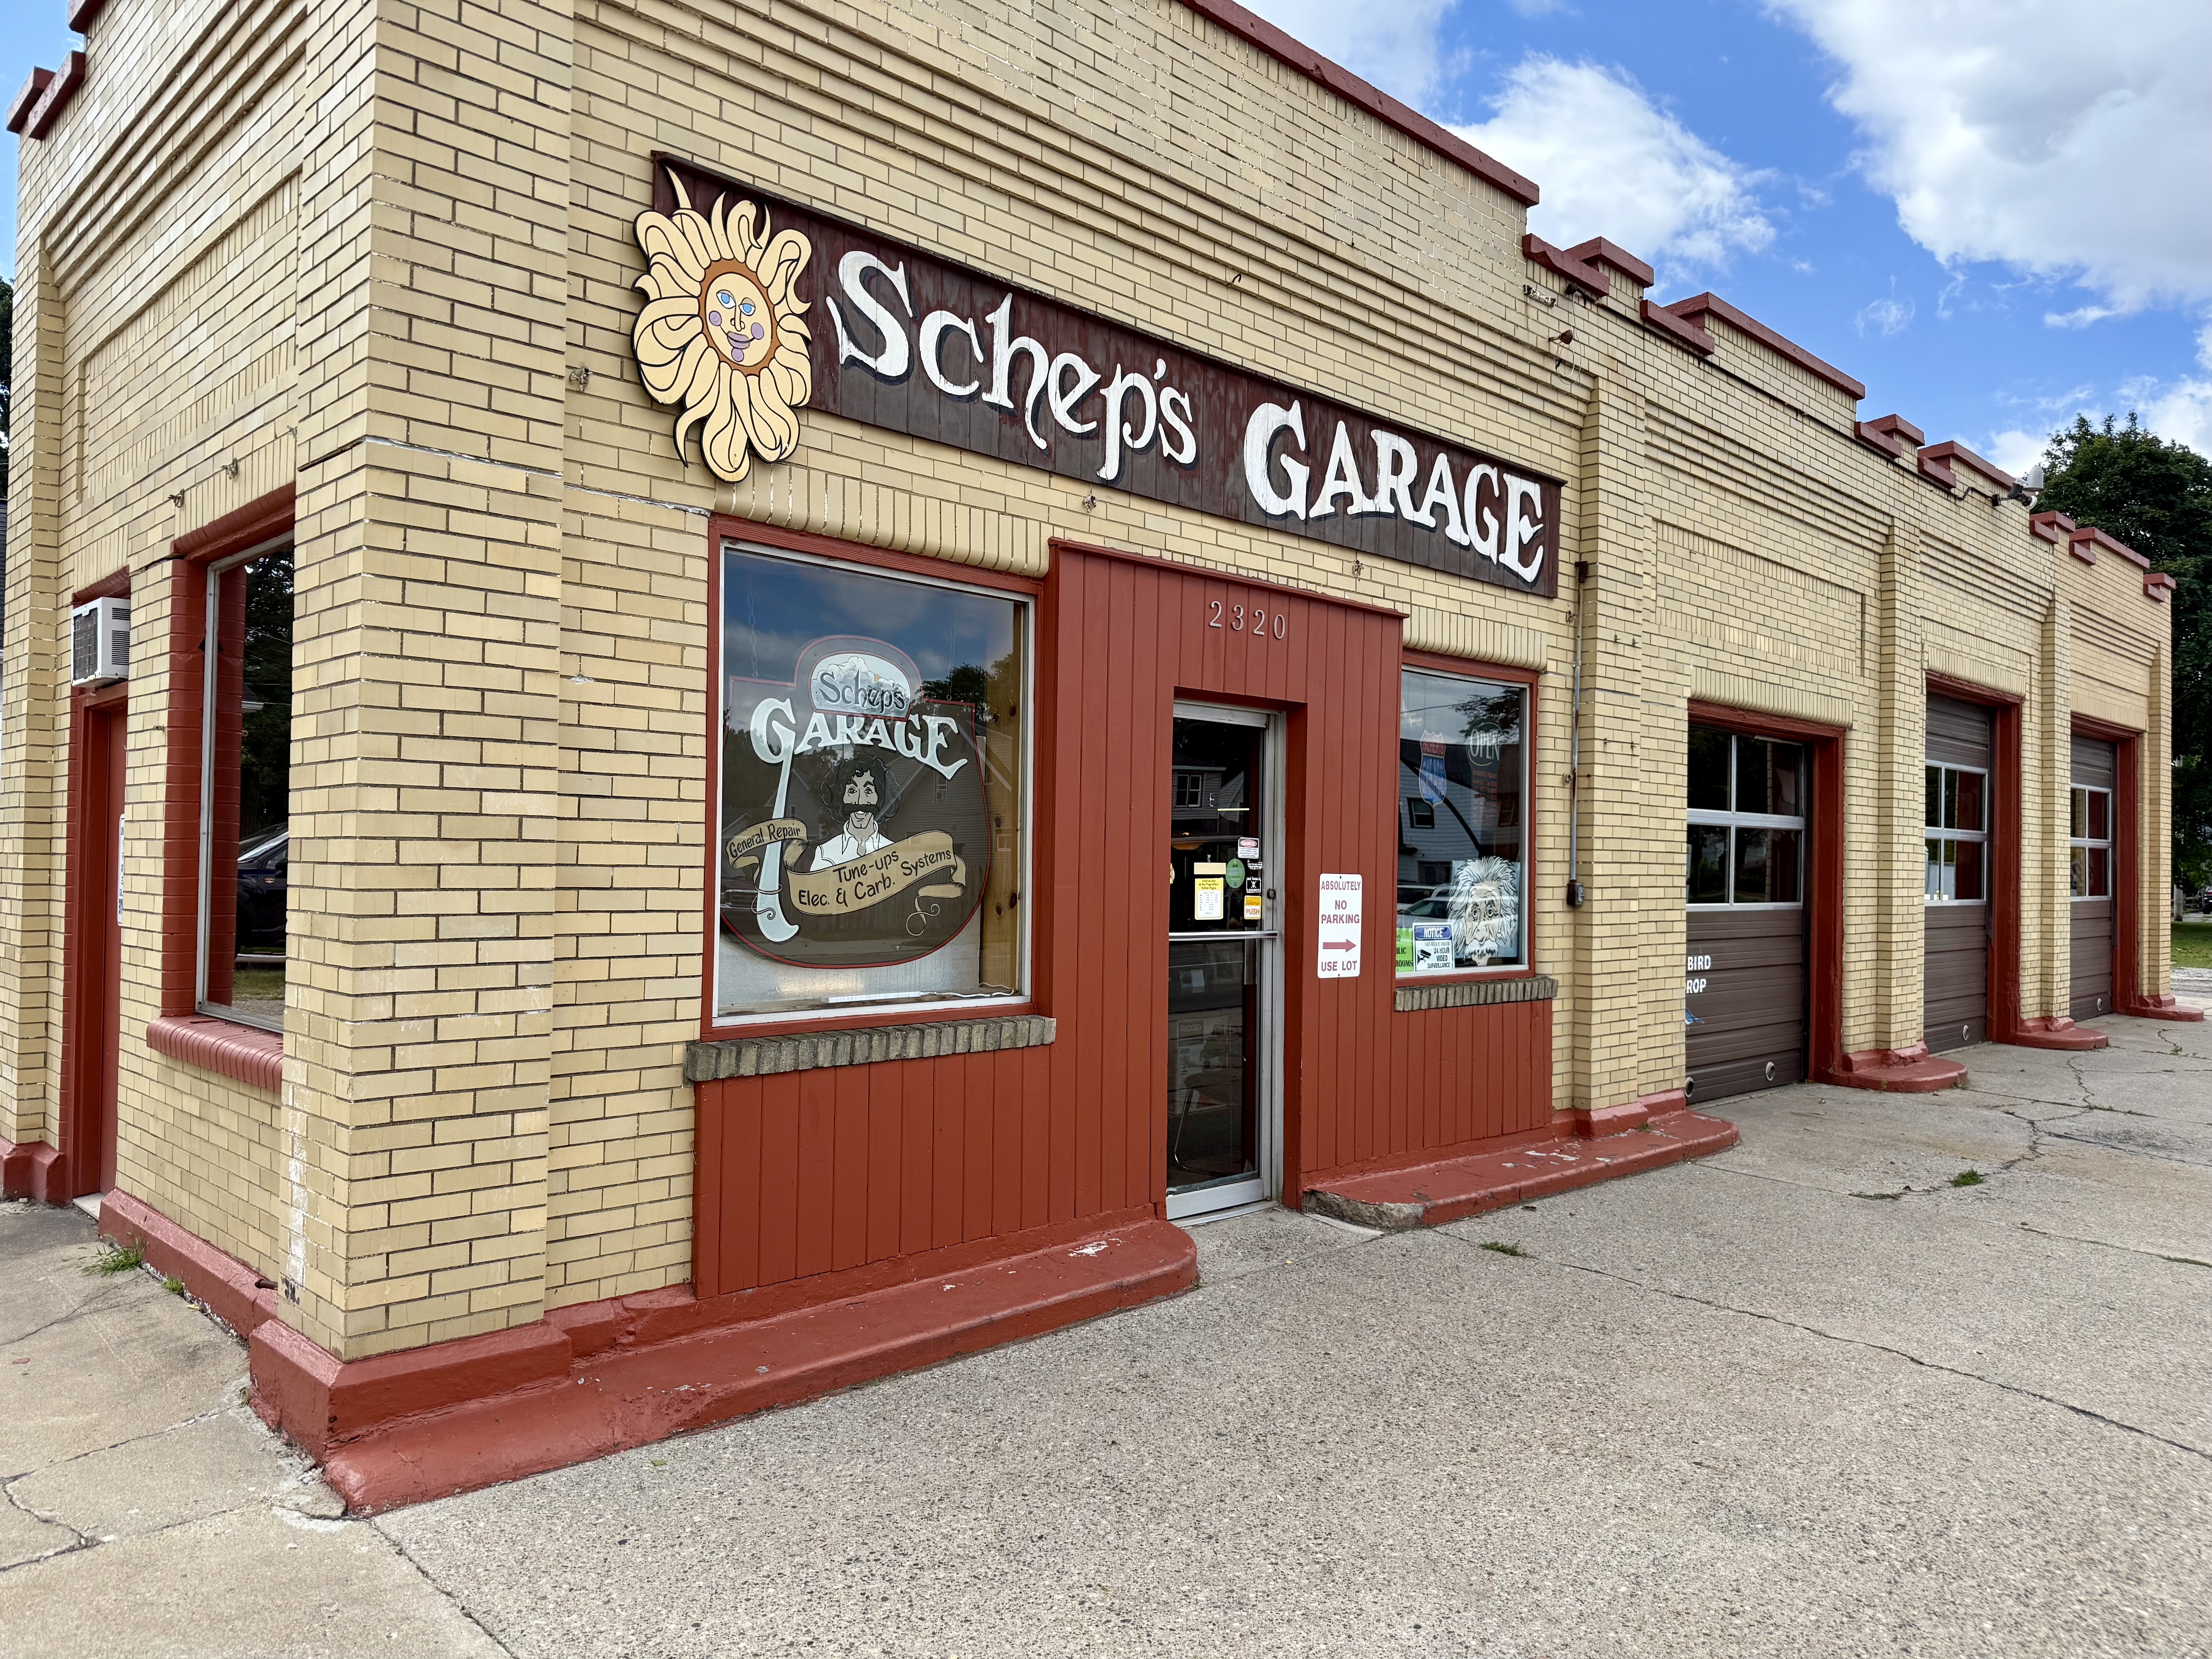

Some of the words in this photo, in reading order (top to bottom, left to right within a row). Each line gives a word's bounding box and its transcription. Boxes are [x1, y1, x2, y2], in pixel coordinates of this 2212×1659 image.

[826, 250, 1197, 481] Schep's
[1244, 399, 1544, 582] GARAGE
[1210, 601, 1286, 639] 2320
[819, 669, 905, 713] Schep's
[750, 697, 968, 780] GARAGE
[1470, 728, 1500, 761] OPEN
[729, 828, 764, 858] General
[767, 823, 800, 840] Repair
[799, 890, 830, 907] Elec.
[836, 888, 848, 907] &
[854, 873, 895, 900] Carb.
[901, 850, 951, 876] Systems
[833, 850, 899, 883] Tune-ups
[1321, 880, 1361, 890] ABSOLUTELY
[1335, 900, 1347, 910] NO
[1321, 914, 1360, 924] PARKING
[1424, 927, 1443, 938] NOTICE
[1321, 961, 1338, 971] USE
[1342, 960, 1357, 970] LOT
[1687, 955, 1711, 970] BIRD
[1686, 978, 1706, 994] ROP
[1180, 1024, 1202, 1033] RIDGID
